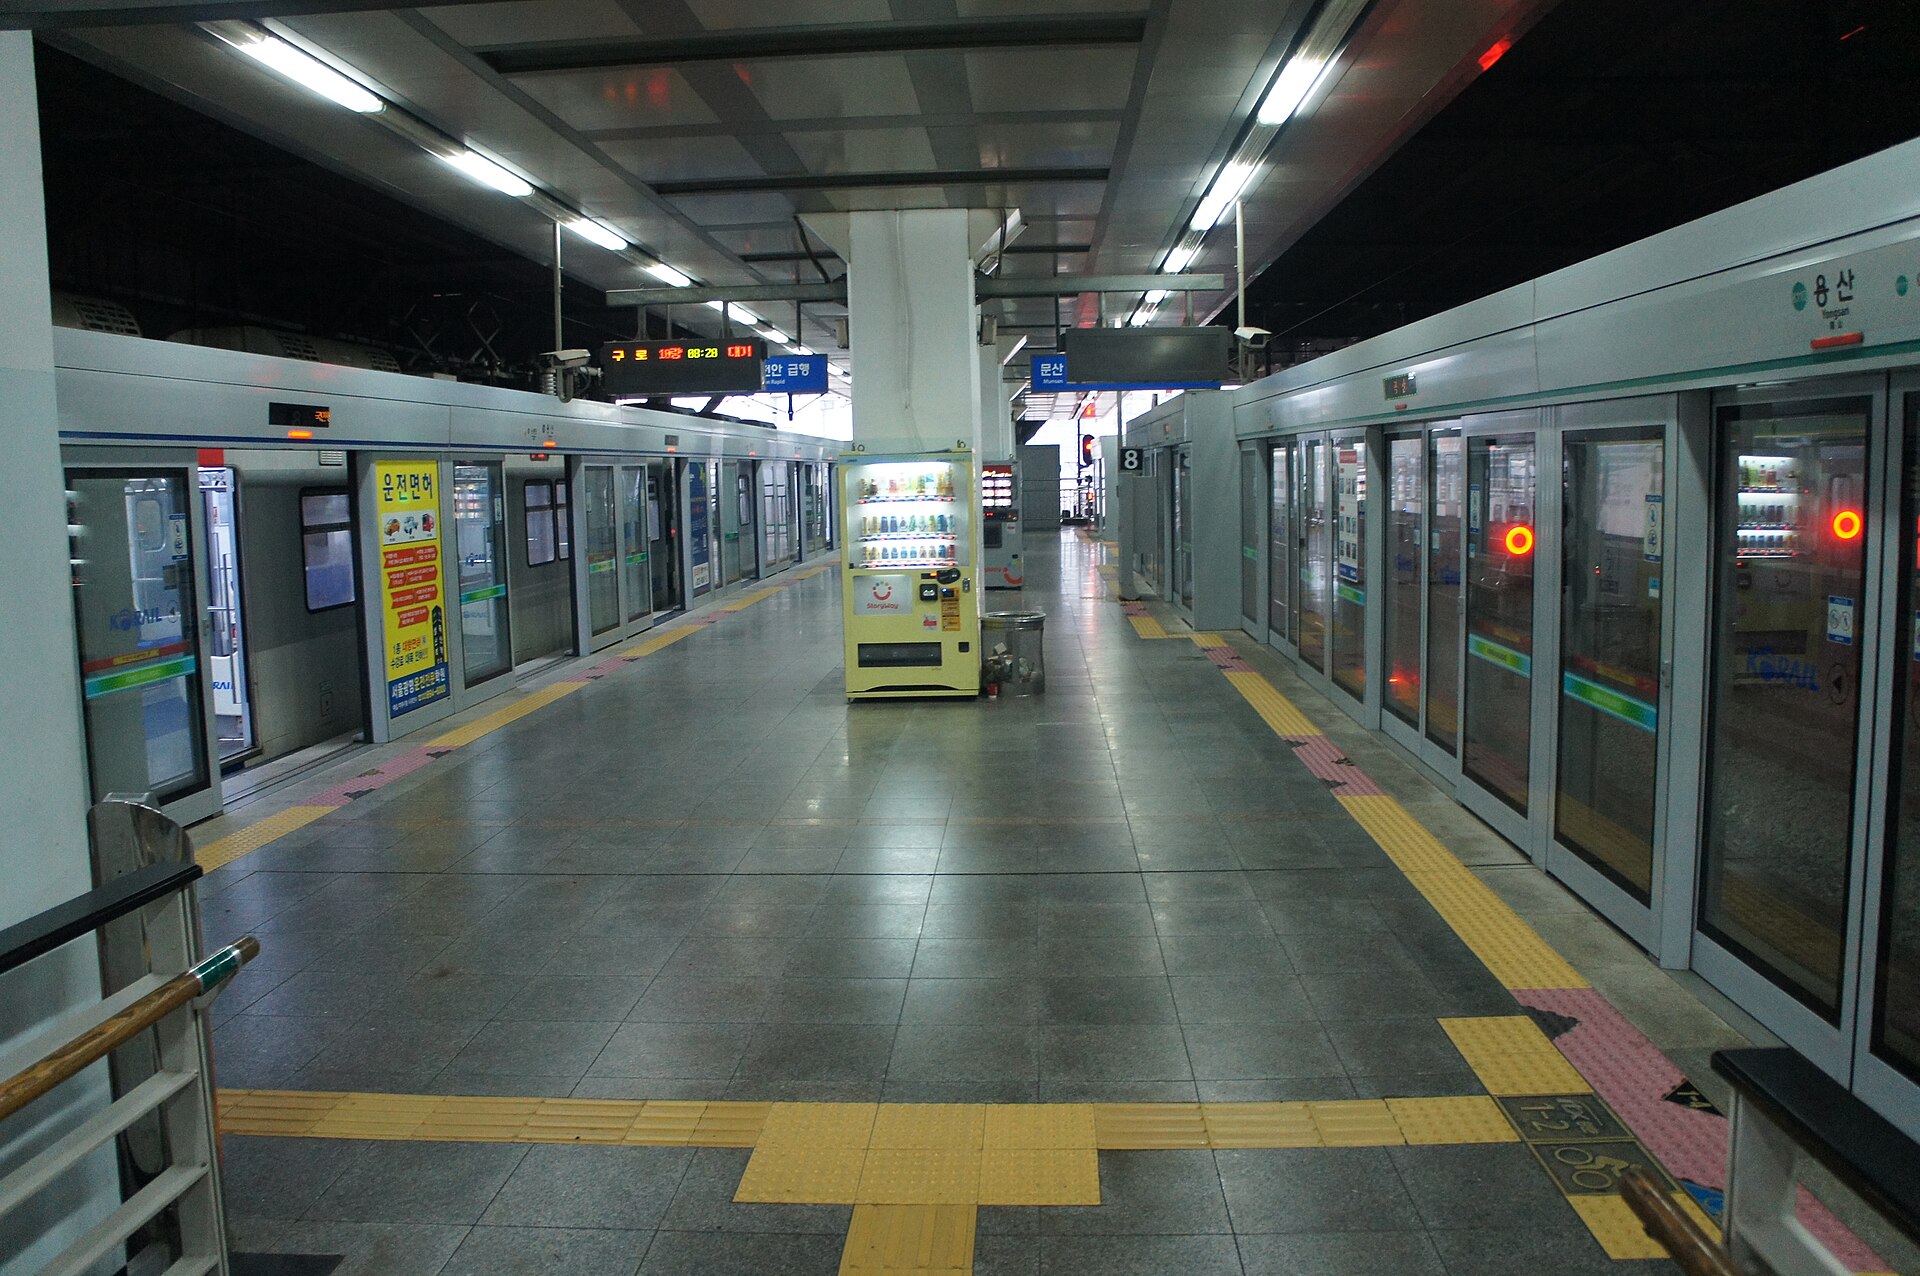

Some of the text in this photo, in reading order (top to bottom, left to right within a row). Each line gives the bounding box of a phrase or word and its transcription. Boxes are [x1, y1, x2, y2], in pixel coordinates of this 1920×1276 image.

[1813, 268, 1855, 307] 용산
[727, 345, 752, 358] 대기
[787, 363, 810, 376] 급행
[1040, 363, 1064, 376] 문산
[1124, 449, 1138, 470] 8
[382, 472, 433, 502] 운전면허
[1519, 1102, 1570, 1132] 1-2
